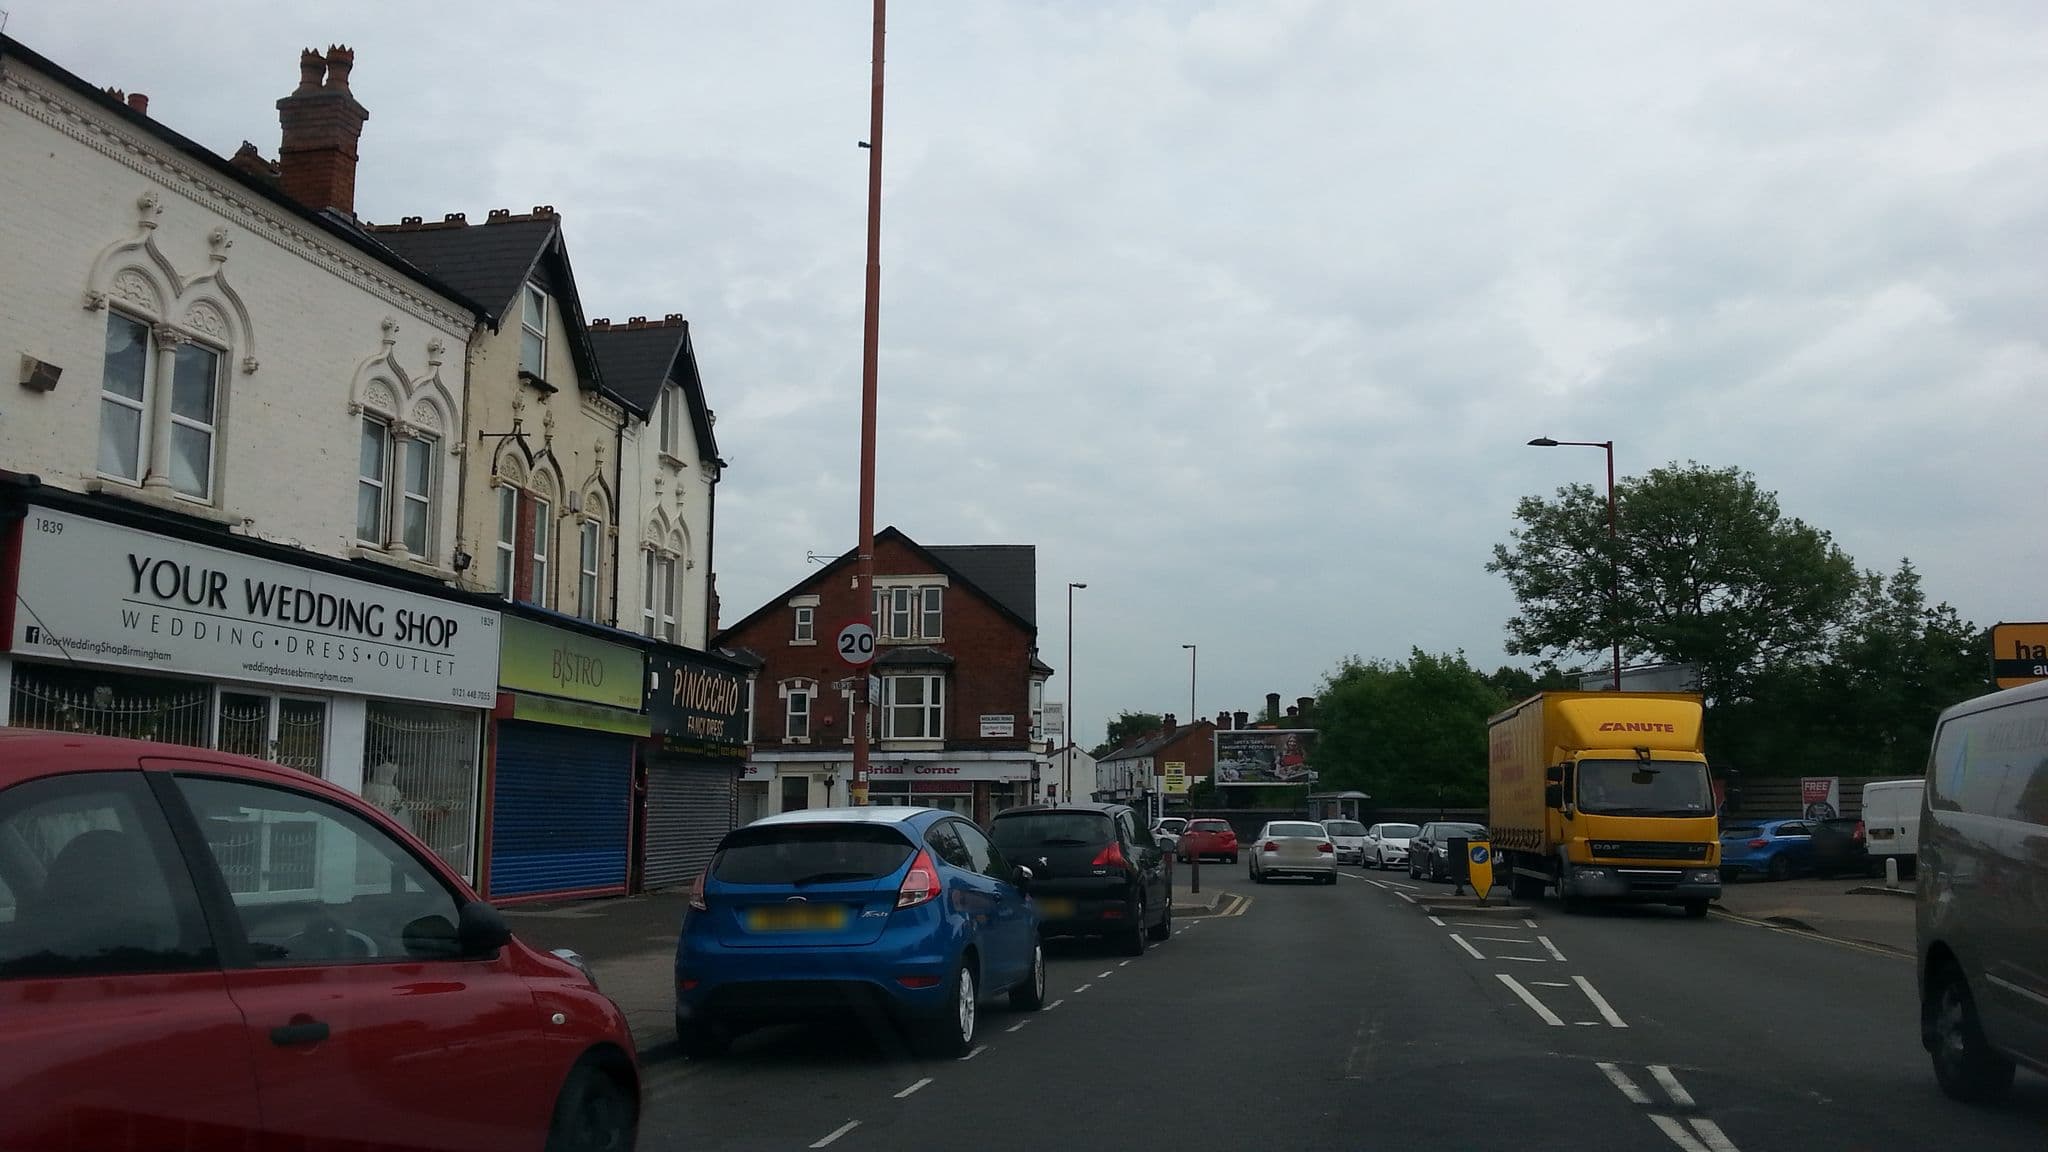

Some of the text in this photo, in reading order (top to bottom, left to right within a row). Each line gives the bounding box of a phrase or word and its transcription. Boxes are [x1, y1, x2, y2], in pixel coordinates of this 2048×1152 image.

[36, 518, 64, 536] 1839
[128, 553, 458, 648] YOUR WEDDING SHOP
[41, 633, 172, 661] YourWeddingShopBirmingham
[122, 609, 455, 676] WEDDING DRESS OUTLET
[839, 633, 873, 655] 20
[242, 661, 354, 684] weddingdressesbirmingham.com
[552, 641, 604, 689] BISTRO
[452, 687, 465, 697] 0121
[672, 665, 738, 716] PINOCCHIO
[687, 715, 724, 737] FANCY DRESS
[1599, 722, 1674, 733] CANUTE
[867, 765, 960, 775] Bridal Corner
[1804, 781, 1829, 791] FREE
